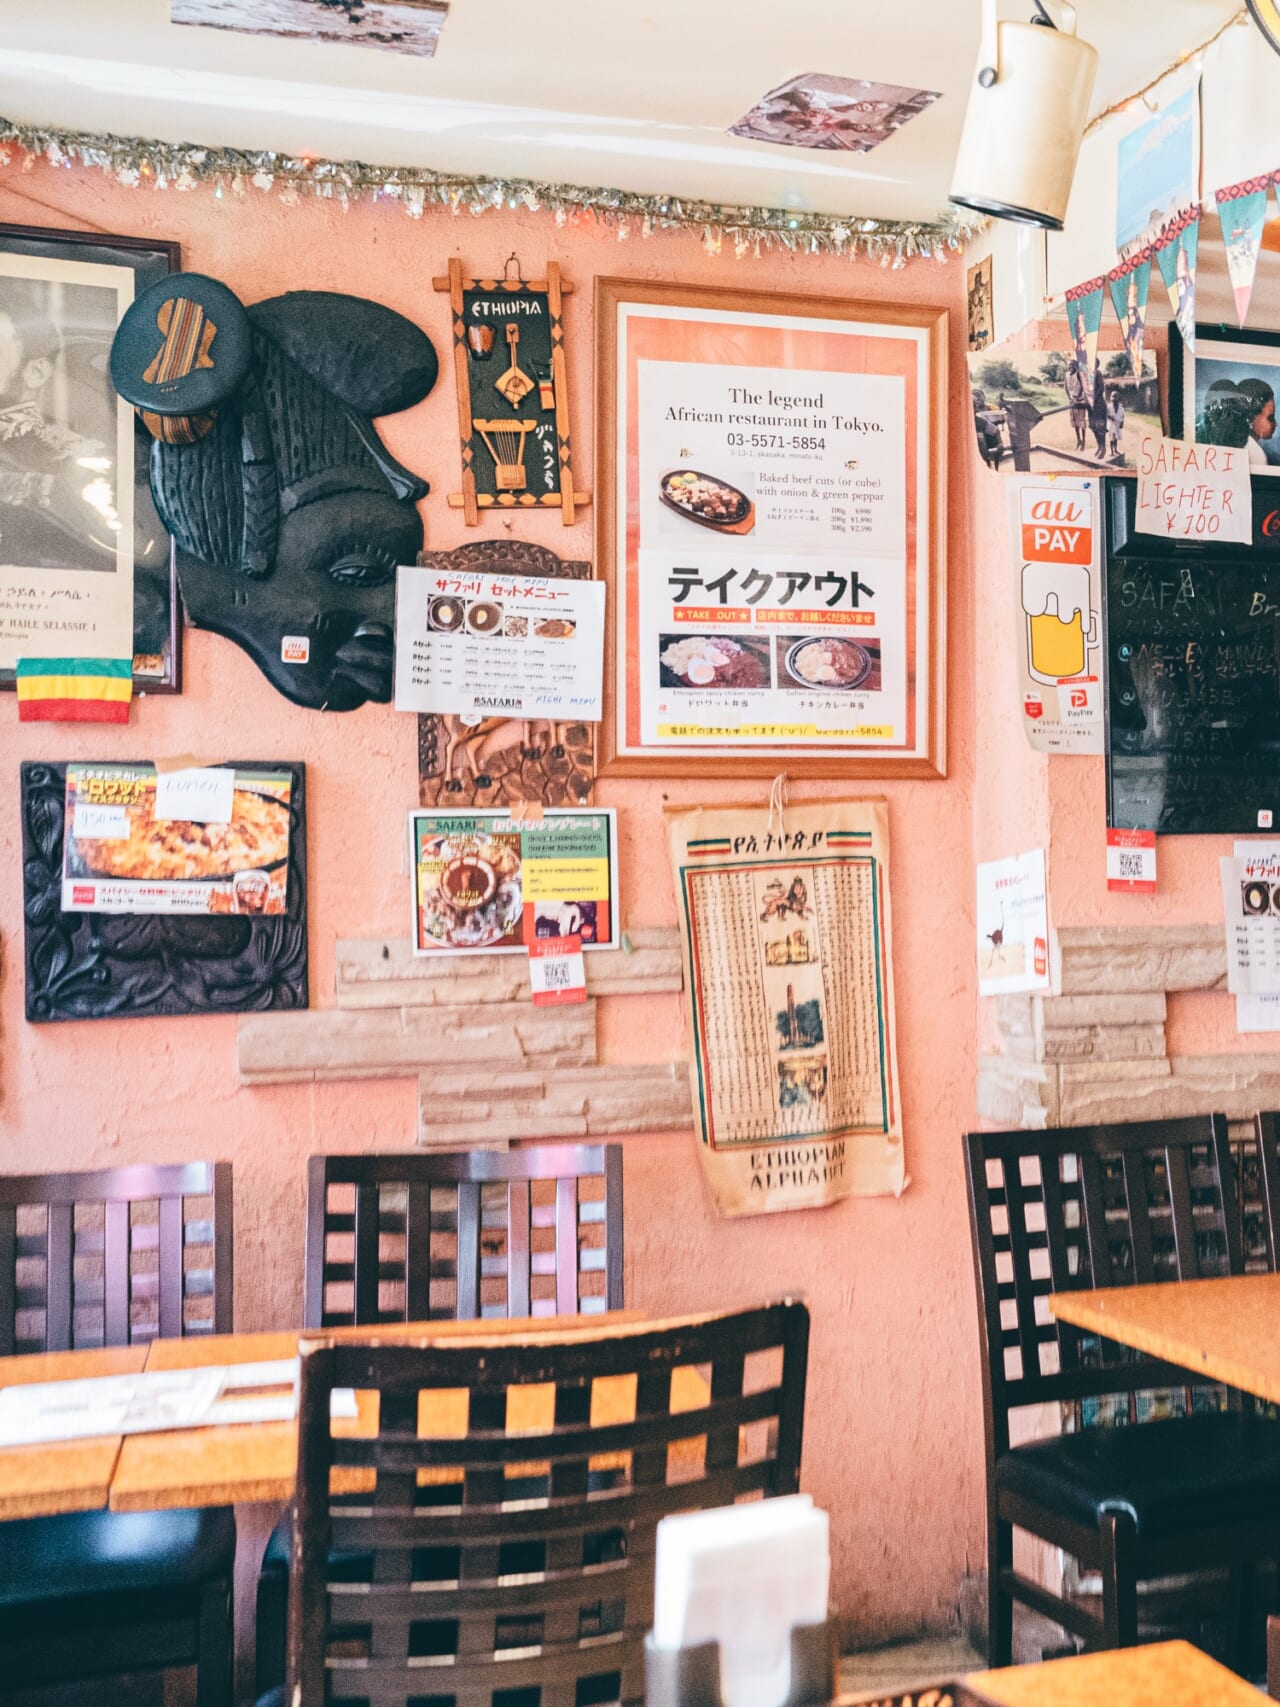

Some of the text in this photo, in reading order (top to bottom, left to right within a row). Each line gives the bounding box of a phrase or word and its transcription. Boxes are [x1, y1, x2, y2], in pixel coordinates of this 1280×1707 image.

[472, 301, 542, 317] ETHIOPIA
[728, 388, 824, 410] The legend
[665, 407, 884, 435] African restaurant in Tokyo.
[727, 433, 826, 450] 03-5571-5854
[1141, 436, 1233, 475] SAFARI
[759, 473, 881, 488] Baked beef cuts (or cube)
[756, 487, 884, 504] with onion & green peppar
[1141, 481, 1233, 515] LIGHTER
[1031, 500, 1084, 521] au
[1166, 512, 1220, 535] ¥ 100
[1034, 528, 1081, 552] PAY
[436, 579, 569, 600] サファリ セットメニュー
[668, 567, 875, 608] テイクアウト
[687, 610, 737, 621] TAKE OUT
[9, 618, 39, 629] HAILE
[43, 621, 88, 632] SELASSIE
[481, 697, 515, 708] SAFARI
[1068, 709, 1094, 718] PayPay
[77, 780, 147, 796] ドロワット
[437, 821, 477, 831] SAFARI
[1246, 866, 1280, 878] サファリ
